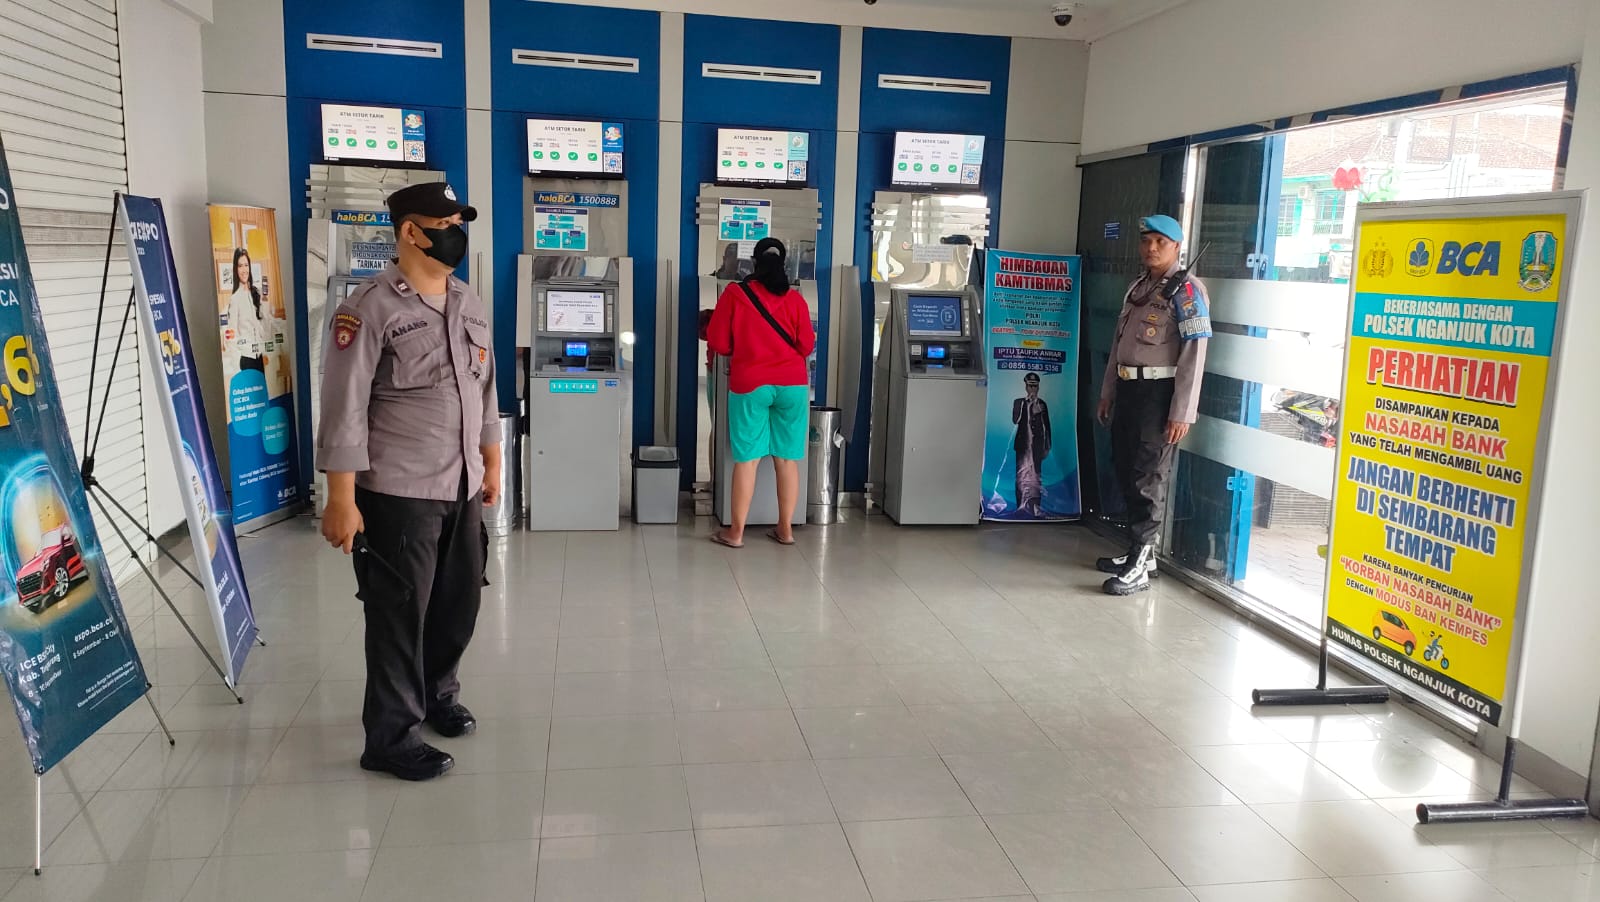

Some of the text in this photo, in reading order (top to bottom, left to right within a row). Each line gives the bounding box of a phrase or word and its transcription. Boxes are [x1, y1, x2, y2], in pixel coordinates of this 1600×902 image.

[578, 196, 617, 206] 1500888
[358, 260, 382, 269] TARIKAN
[1000, 257, 1068, 276] HIMBAUAN
[1436, 240, 1501, 276] BCA
[995, 272, 1073, 292] KAMTIBMAS
[1384, 299, 1514, 322] BEKERJASAMA DENGAN
[1364, 314, 1536, 350] POLSEK NGANJUK KOTA
[998, 346, 1014, 355] IPTU
[1016, 346, 1039, 356] TAUFIK
[1008, 361, 1026, 370] 0856
[1367, 347, 1520, 408] PERHATIAN
[1376, 398, 1500, 432] DISAMPAIKAN KEPADA
[1366, 412, 1508, 460] NASABAH BANK
[1350, 432, 1522, 484] YANG TELAH MENGAMBIL UANG
[284, 486, 296, 498] BCA
[1348, 456, 1516, 528] JANGAN BERHENTI
[1356, 488, 1496, 555] DI SEMBARANG
[1384, 525, 1456, 573] TEMPAT
[1340, 556, 1502, 630] “KORBAN NASABAH BANK”
[1364, 554, 1474, 603] KARENA BANYAK PENCURIAN
[1346, 578, 1488, 646] DENGAN MODUS BAN KEMPES
[19, 672, 40, 684] Kab.
[20, 656, 38, 672] ICE
[1331, 626, 1491, 718] HUMAS POLSEK NGANJUK KOTA
